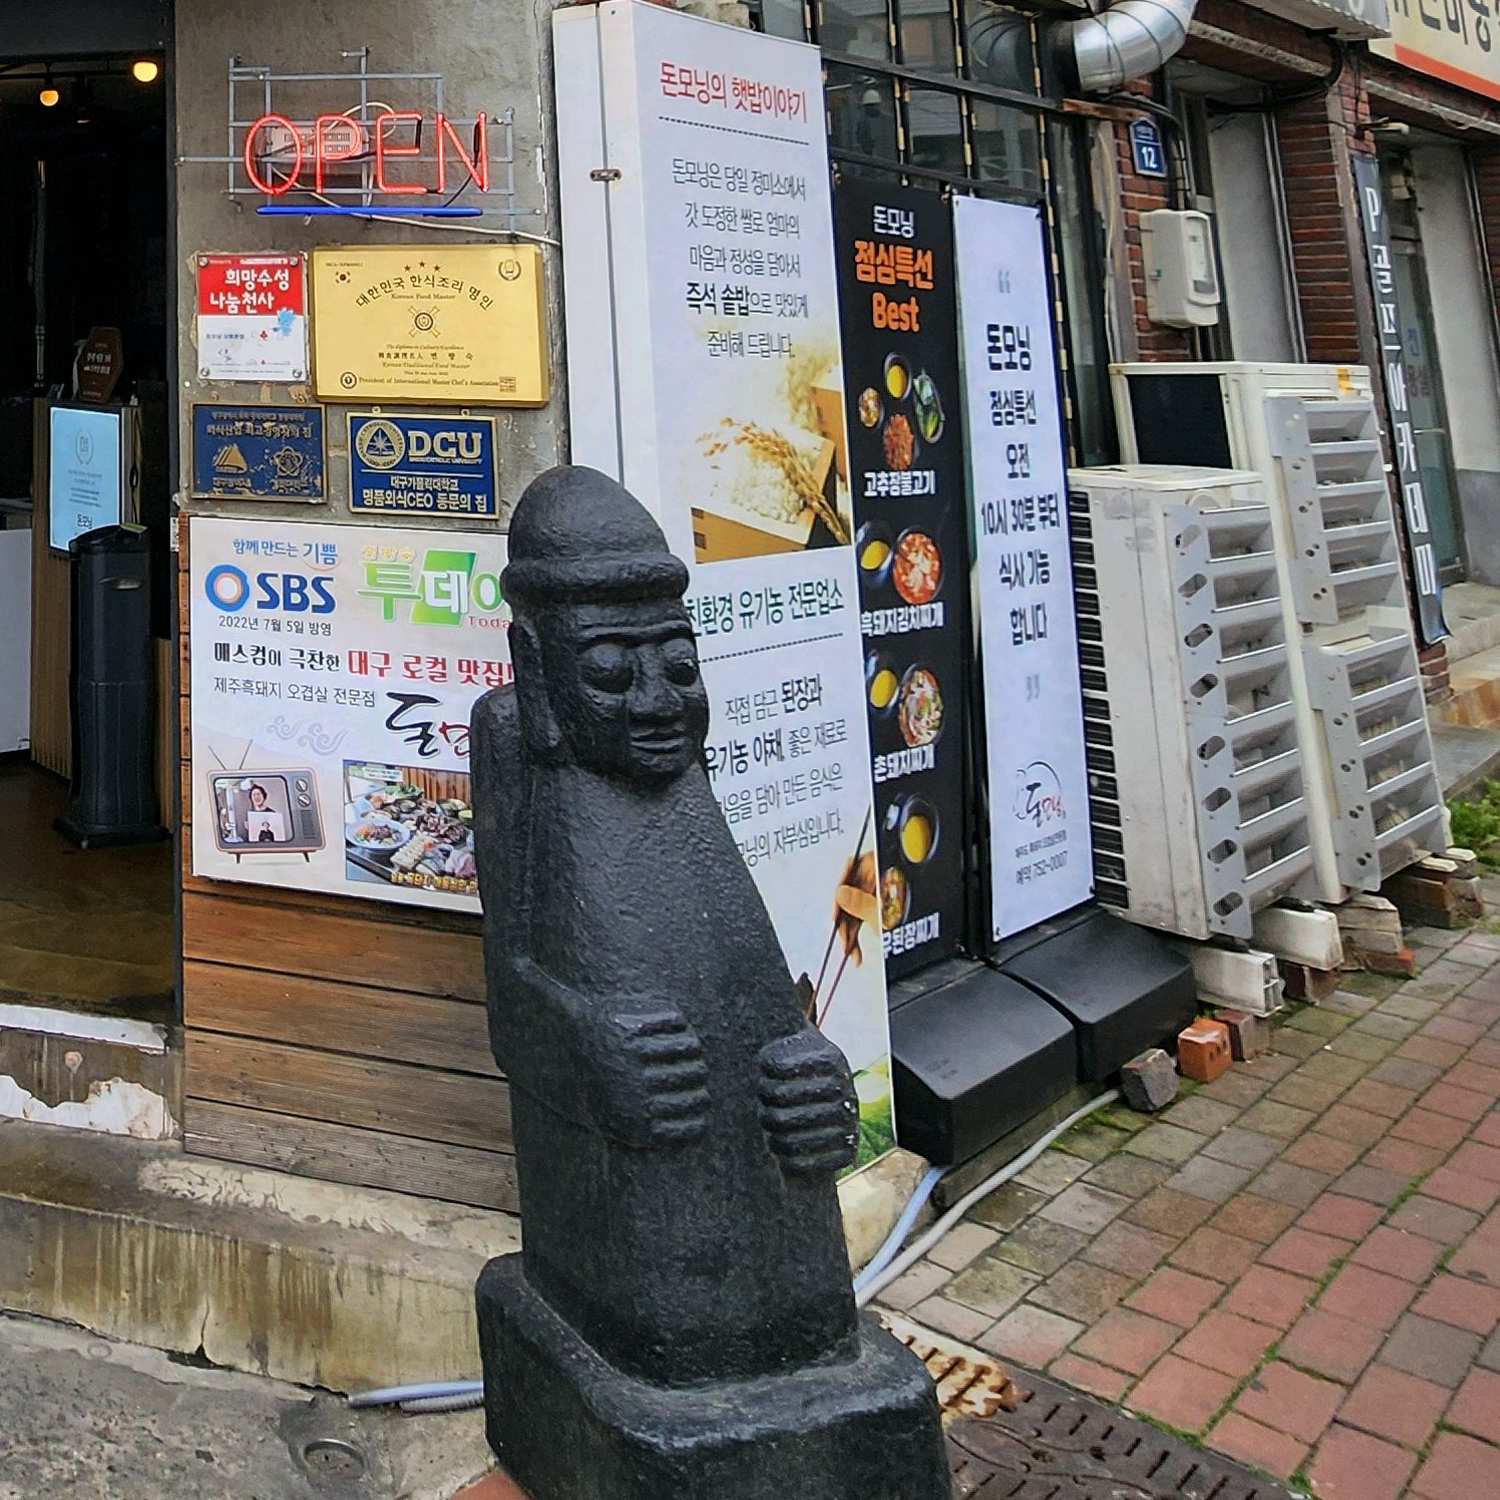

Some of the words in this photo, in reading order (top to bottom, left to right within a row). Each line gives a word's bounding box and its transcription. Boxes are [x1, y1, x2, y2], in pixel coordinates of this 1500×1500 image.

[659, 60, 728, 109] 돈모닝의
[730, 75, 808, 123] 햇밥이야기
[244, 112, 490, 195] OPEN
[1141, 146, 1158, 169] 12
[672, 158, 722, 189] 돈모닝은
[724, 166, 749, 193] 당일
[750, 171, 806, 200] 정미소에서
[685, 202, 698, 228] 갓
[702, 205, 738, 232] 도정한
[740, 209, 764, 235] 쌀로
[766, 212, 800, 240] 엄마의
[873, 205, 915, 238] 돈모닝
[689, 244, 727, 274] 마음과
[729, 248, 765, 276] 정성을
[767, 251, 801, 278] 담아서
[855, 240, 934, 290] 점심특선
[225, 269, 290, 291] 희망수성
[356, 276, 405, 308] 대한민국
[410, 275, 464, 293] 한식조리
[210, 292, 275, 314] 나눔천사
[686, 281, 717, 315] 즉석
[721, 283, 773, 316] 솥밥으로
[872, 292, 920, 333] Best
[707, 330, 744, 358] 준비해
[986, 323, 1031, 371] 돈모닝
[990, 390, 1037, 426] 점심특선
[408, 430, 482, 458] DCU
[1006, 443, 1030, 479] 오전
[864, 469, 936, 498] 고추장불고기
[475, 494, 487, 512] 집
[981, 498, 1007, 535] 10시
[1010, 493, 1035, 532] 30분
[1037, 492, 1060, 529] 부터
[233, 539, 260, 556] 함께
[261, 540, 299, 558] 만드는
[303, 543, 338, 566] 기쁨
[999, 552, 1026, 591] 식사
[1029, 548, 1051, 586] 가능
[257, 572, 337, 615] SBS
[739, 587, 784, 629] 유기농
[788, 578, 845, 620] 전문업소
[219, 615, 259, 631] 2022년
[264, 619, 281, 633] 7월
[286, 621, 304, 635] 5일
[309, 622, 332, 637] 방영
[1010, 602, 1048, 646] 합니다
[214, 642, 282, 667] 매스컴이
[289, 648, 341, 672] 극찬한
[348, 650, 392, 679] 대구
[402, 654, 448, 683] 로컬
[214, 677, 282, 699] 제주흑돼지
[287, 684, 329, 704] 오겹살
[333, 686, 376, 708] 전문점
[725, 694, 749, 727] 직접
[754, 689, 778, 721] 담근
[781, 673, 822, 714] 된장과
[788, 727, 812, 758] 좋은
[756, 781, 780, 815] 담아
[783, 774, 807, 806] 만든
[810, 763, 843, 797] 음식은
[883, 912, 940, 960] 우된장찌개
